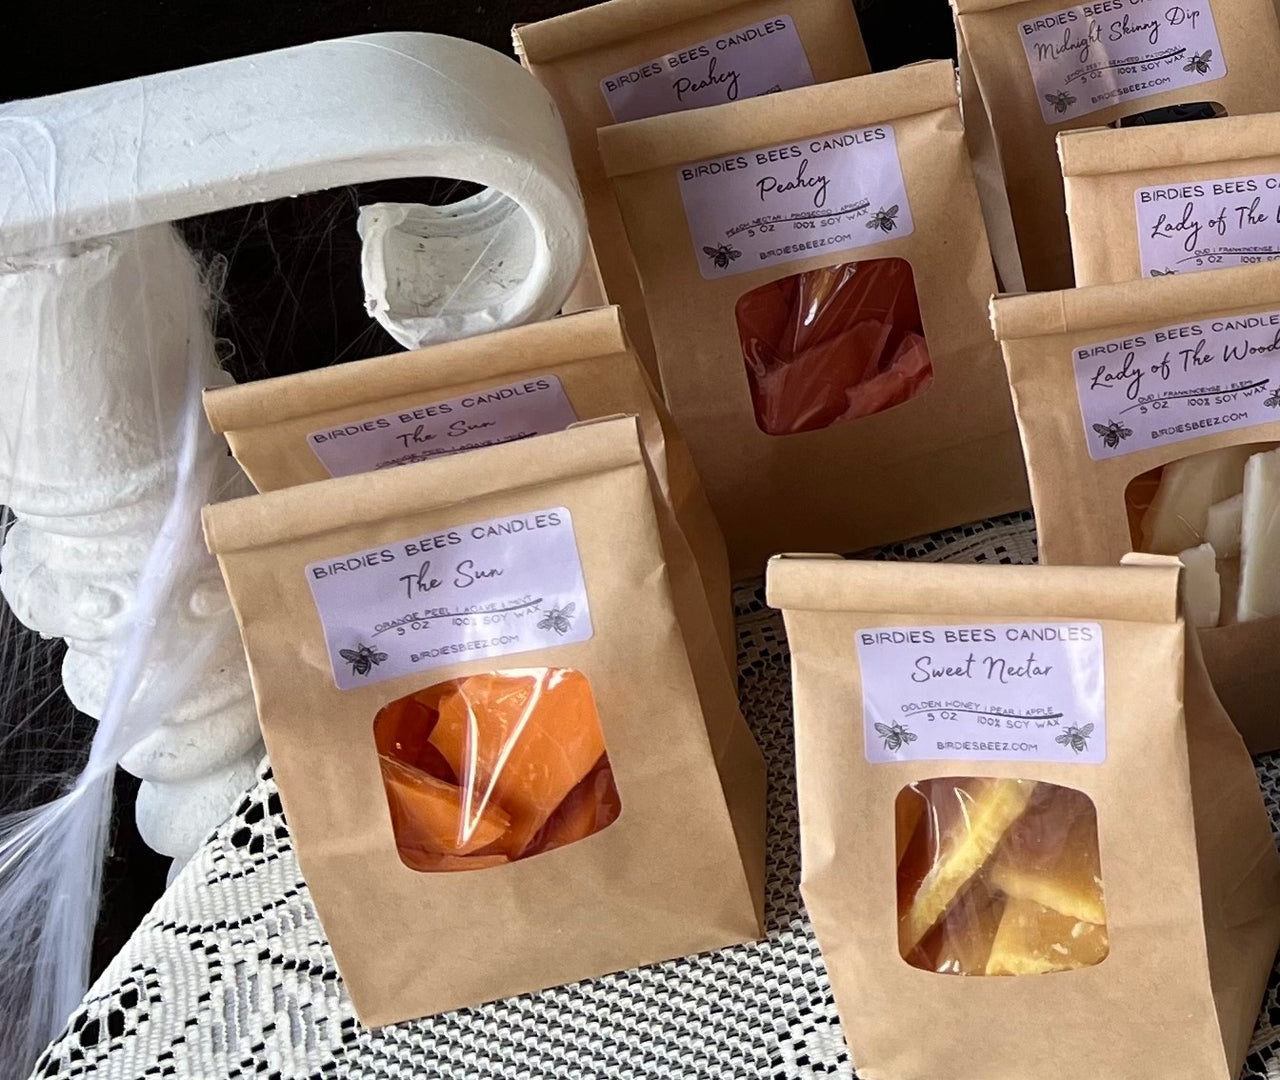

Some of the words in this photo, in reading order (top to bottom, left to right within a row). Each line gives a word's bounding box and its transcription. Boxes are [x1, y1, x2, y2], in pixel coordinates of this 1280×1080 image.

[1022, 11, 1078, 36] BIRDIES
[1083, 0, 1123, 17] BEES
[1034, 28, 1102, 62] Midnight
[1109, 14, 1161, 44] Skinny
[1165, 7, 1200, 28] Dip
[682, 157, 748, 181] BIRDIES
[756, 146, 802, 165] BEES
[810, 128, 885, 153] CANDLES
[1140, 185, 1205, 203] BIRDIES
[1213, 180, 1258, 196] BEES
[1151, 202, 1202, 252] Lady
[1208, 207, 1227, 235] of
[1235, 197, 1269, 230] The
[1079, 336, 1146, 360] BIRDIES
[1155, 326, 1203, 344] BEES
[1090, 352, 1144, 400] Lady
[1151, 354, 1171, 380] of
[1180, 340, 1214, 372] The
[396, 424, 436, 449] The
[448, 420, 496, 438] Sun
[313, 550, 395, 580] BIRDIES
[405, 532, 462, 557] BEES
[472, 513, 562, 540] CANDLES
[399, 561, 442, 600] The
[454, 559, 504, 589] Sun
[861, 630, 935, 645] BIRDIES
[945, 629, 996, 643] BEES
[1006, 628, 1093, 642] CANDLES
[911, 653, 974, 682] Sweet
[982, 652, 1052, 684] Nectar
